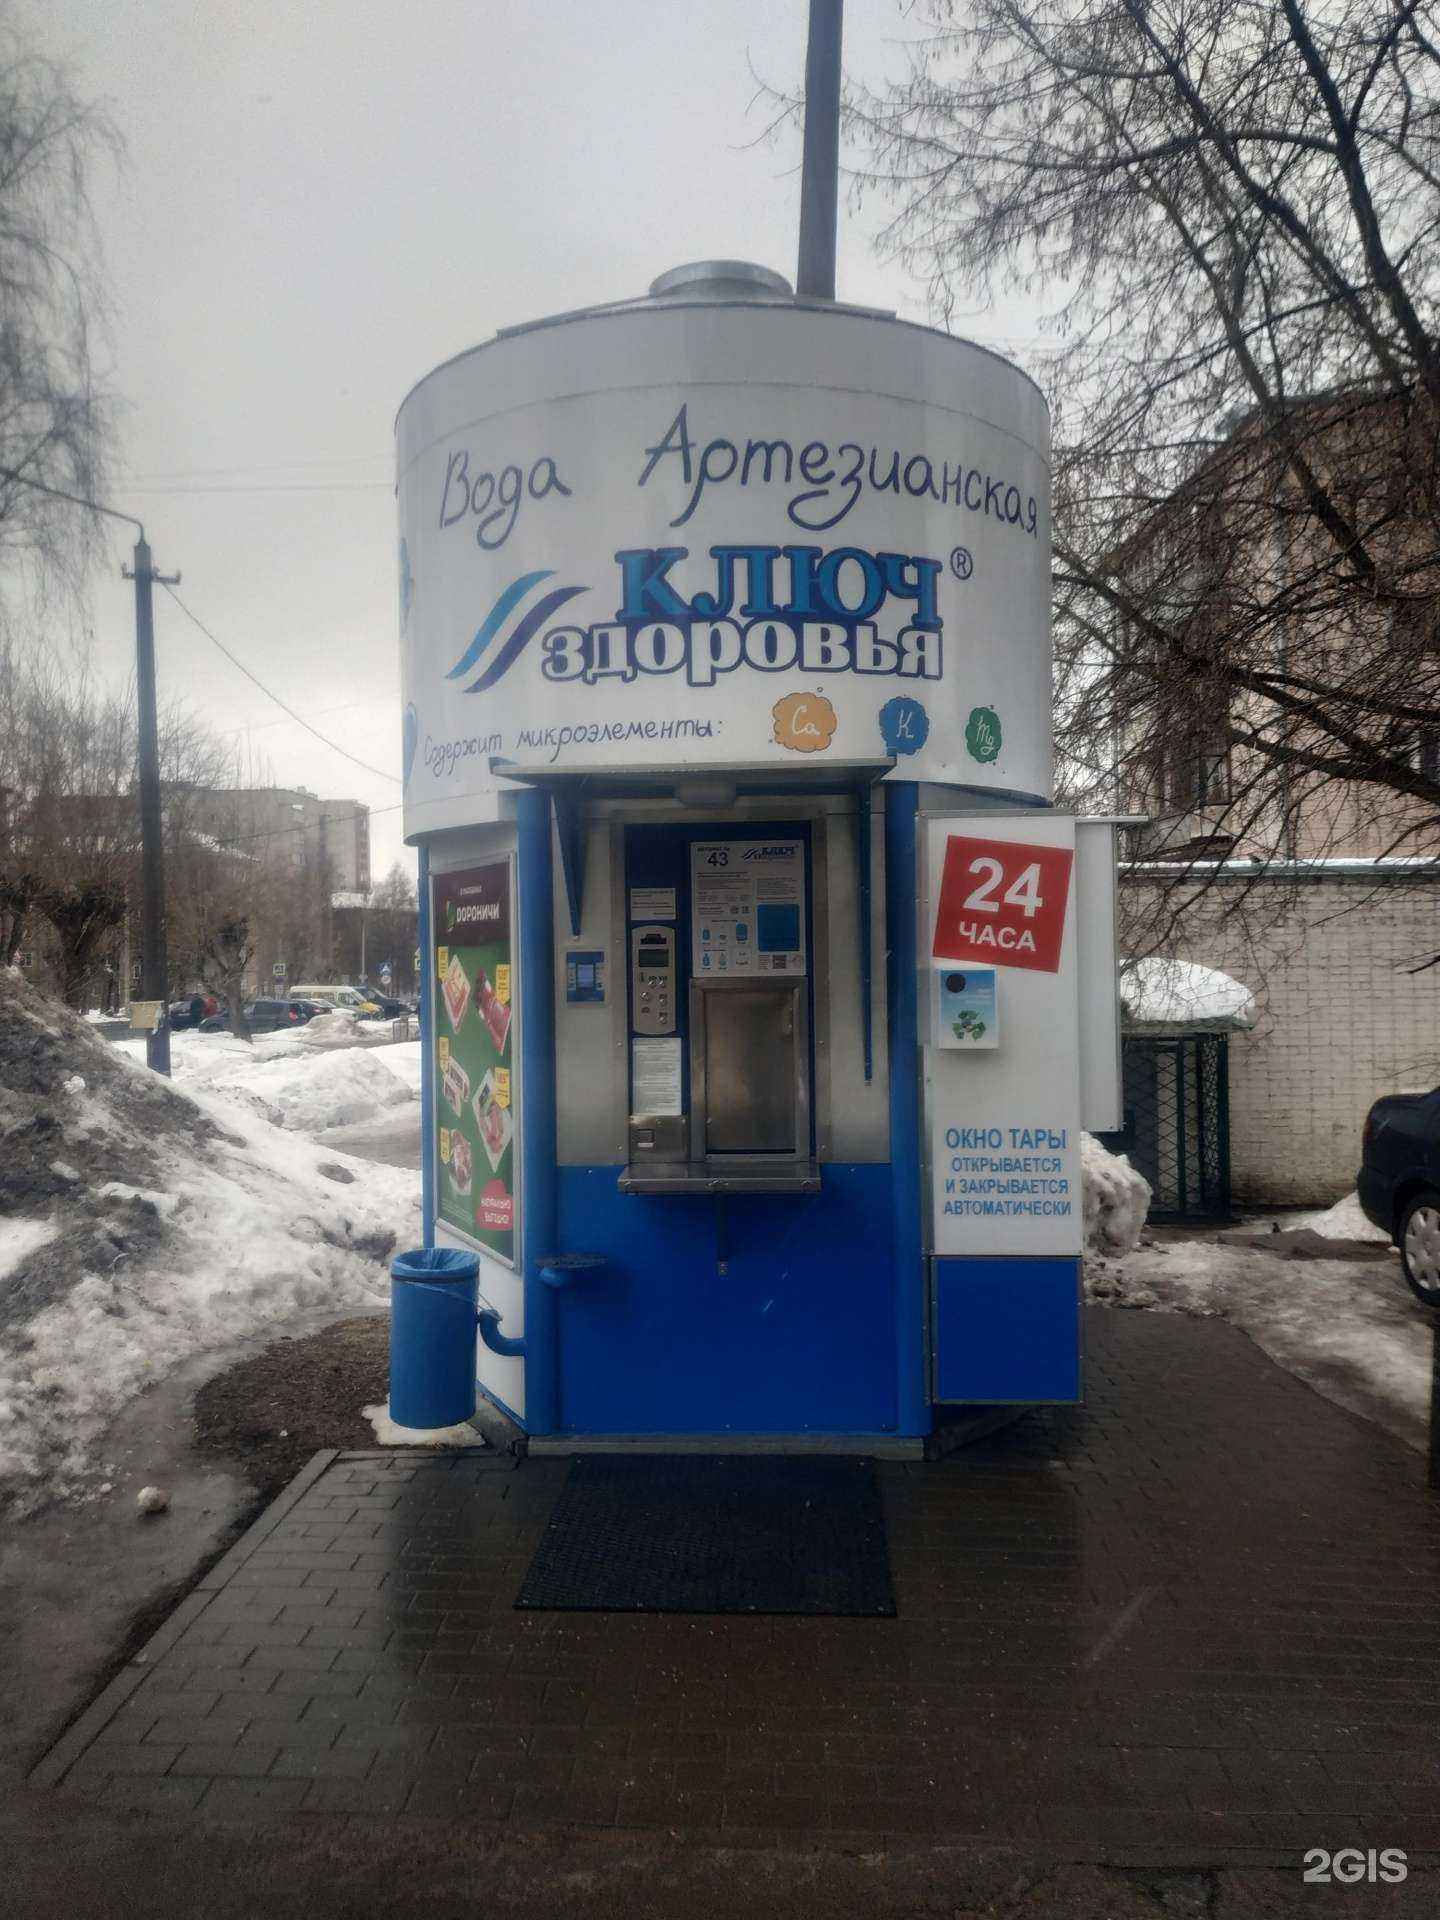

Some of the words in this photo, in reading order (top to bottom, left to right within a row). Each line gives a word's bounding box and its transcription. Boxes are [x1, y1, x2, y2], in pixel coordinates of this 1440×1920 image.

[440, 450, 571, 550] Вода
[638, 403, 1038, 540] Артезианская
[615, 545, 942, 627] КЛЮЧ
[424, 732, 501, 777] Содержит
[517, 719, 723, 762] микроэлементы:
[707, 851, 729, 867] 43
[962, 857, 1043, 917] 24
[959, 920, 1036, 952] ЧАСА
[945, 1128, 1002, 1150] ОКНО
[1008, 1129, 1066, 1149] ТАРЫ
[951, 1157, 1062, 1173] ОТКРЫВАЕТСЯ
[945, 1179, 956, 1195] И
[959, 1179, 1069, 1195] ЗАКРЫВАЕТСЯ
[944, 1199, 1071, 1216] АВТОМАТИЧЕСКИ
